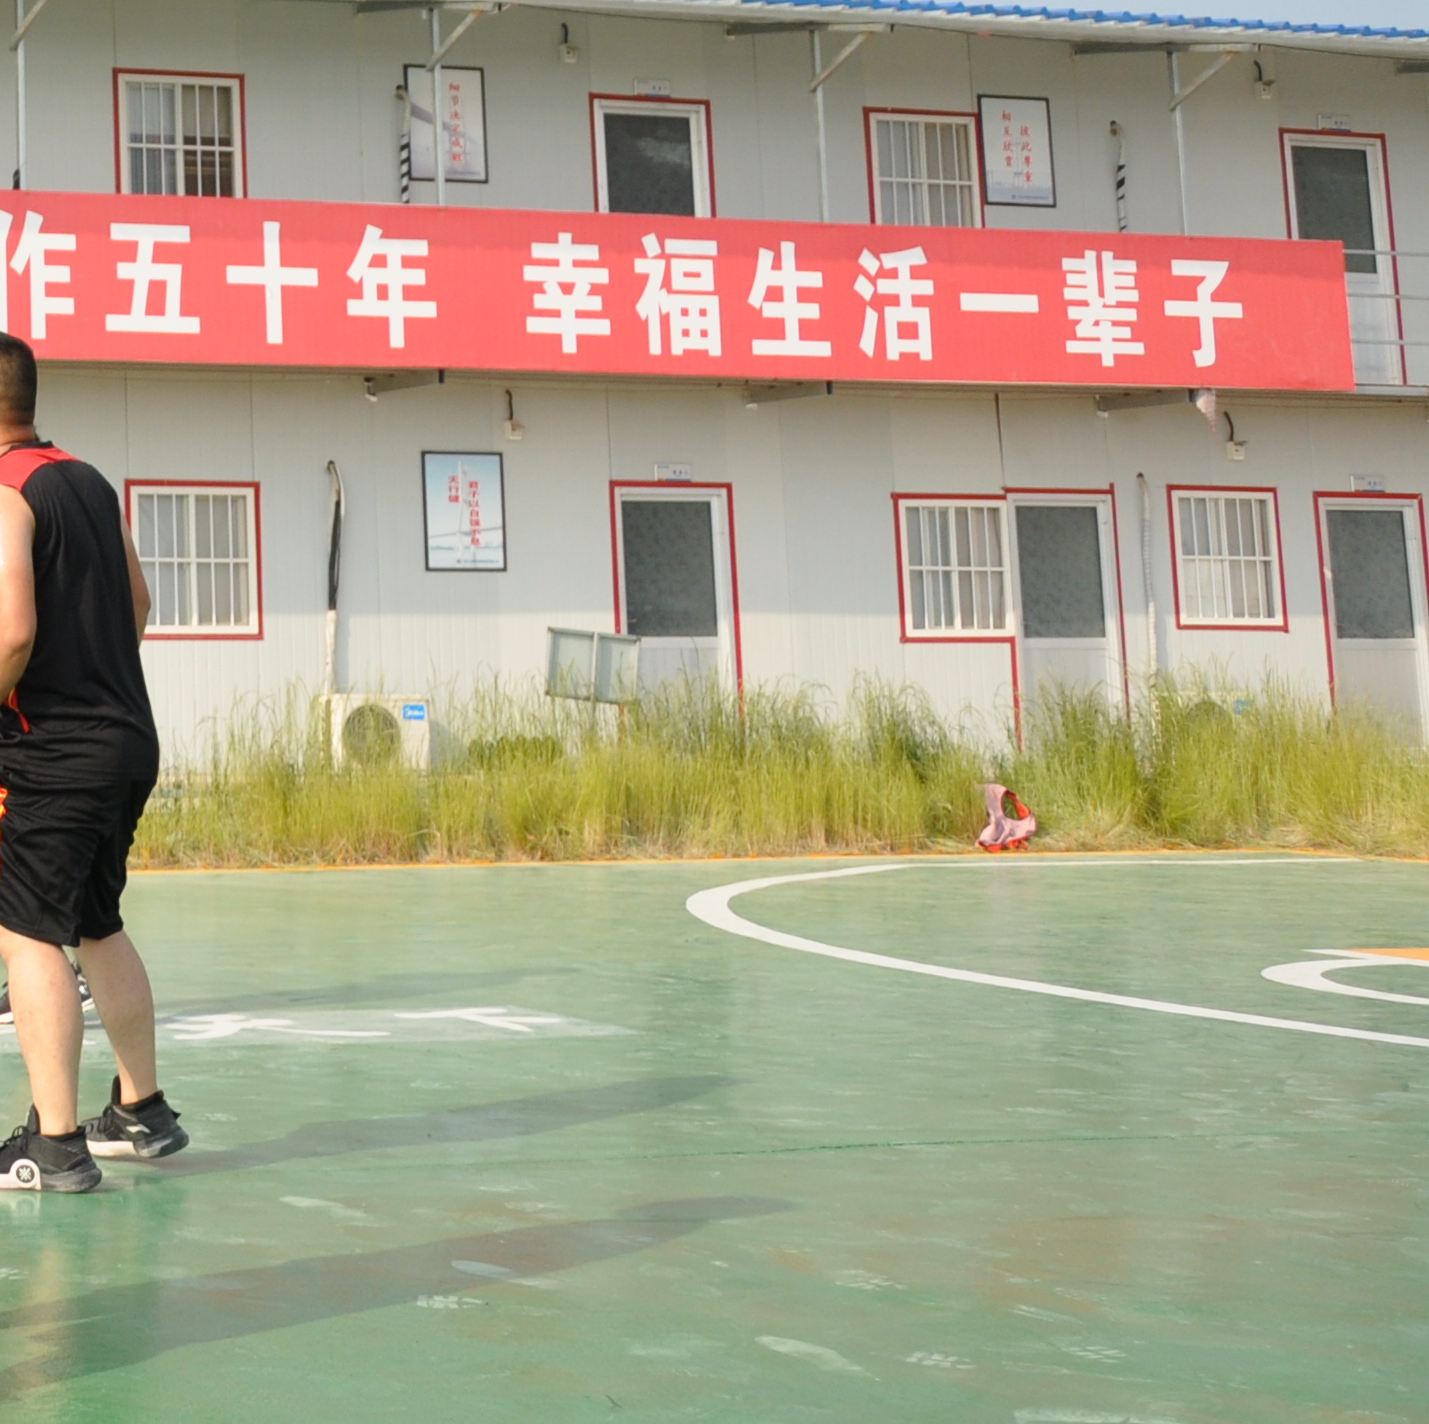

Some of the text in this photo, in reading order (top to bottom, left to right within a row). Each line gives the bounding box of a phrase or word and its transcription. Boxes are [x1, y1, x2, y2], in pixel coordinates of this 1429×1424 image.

[522, 231, 1244, 368] 幸福生活一辈子
